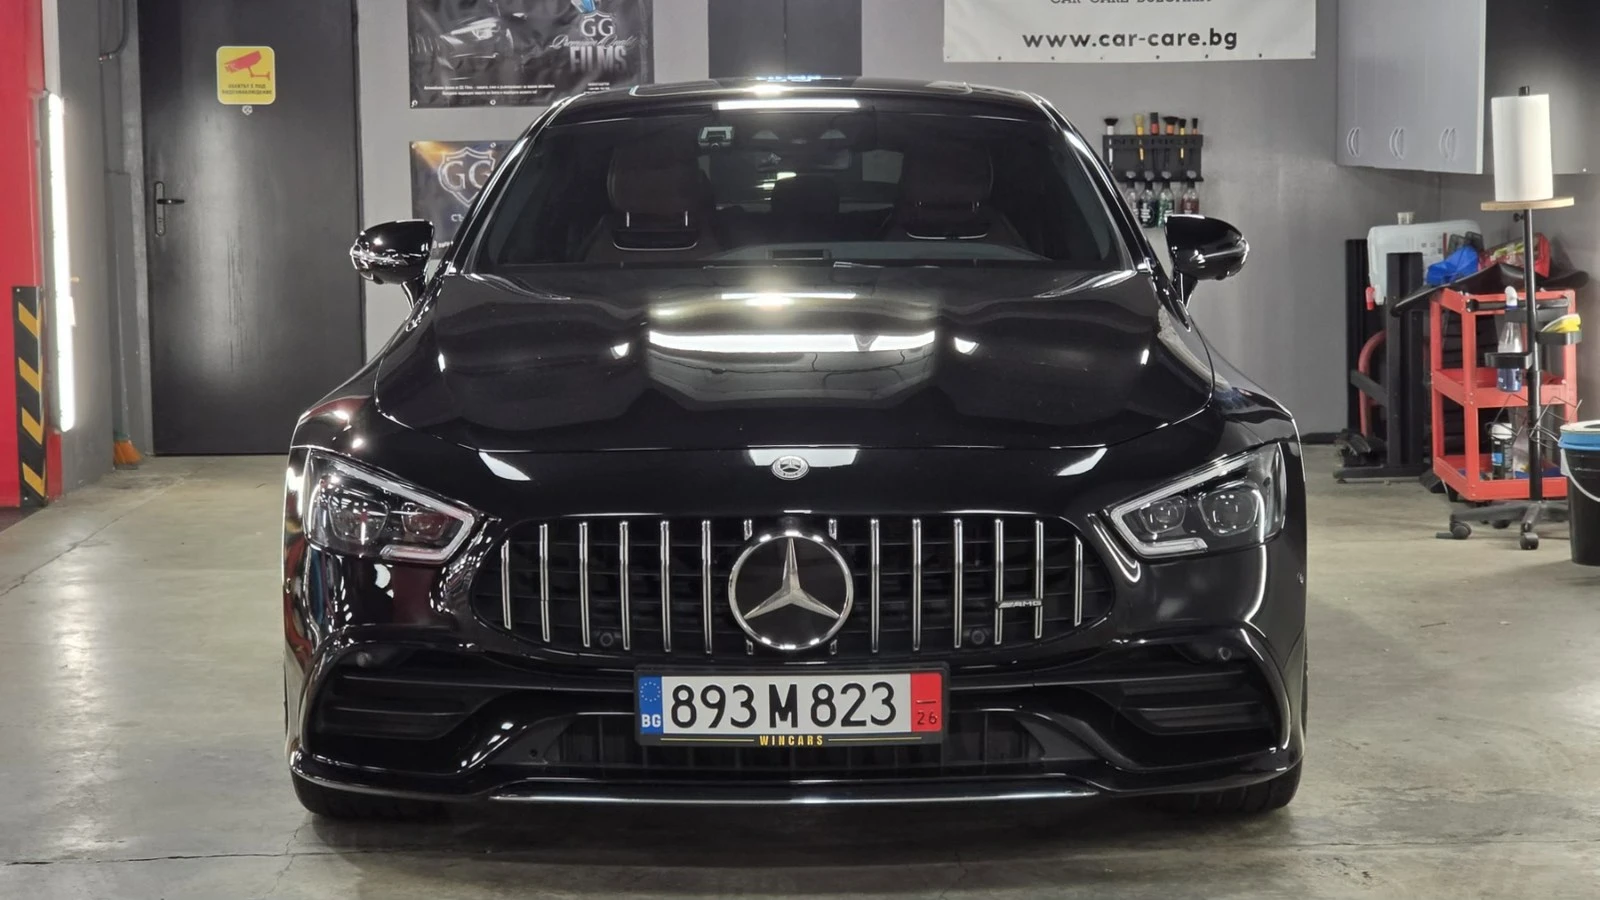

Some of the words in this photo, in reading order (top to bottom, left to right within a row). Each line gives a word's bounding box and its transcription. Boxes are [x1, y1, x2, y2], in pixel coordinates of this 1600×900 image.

[581, 18, 614, 37] GG
[1022, 28, 1238, 50] www.car-care.bg
[570, 45, 627, 73] FILMS
[671, 684, 757, 728] 893
[768, 683, 799, 728] M
[810, 682, 897, 728] 823
[641, 714, 661, 728] BG
[917, 711, 937, 725] 26
[759, 735, 823, 746] WINCARS
